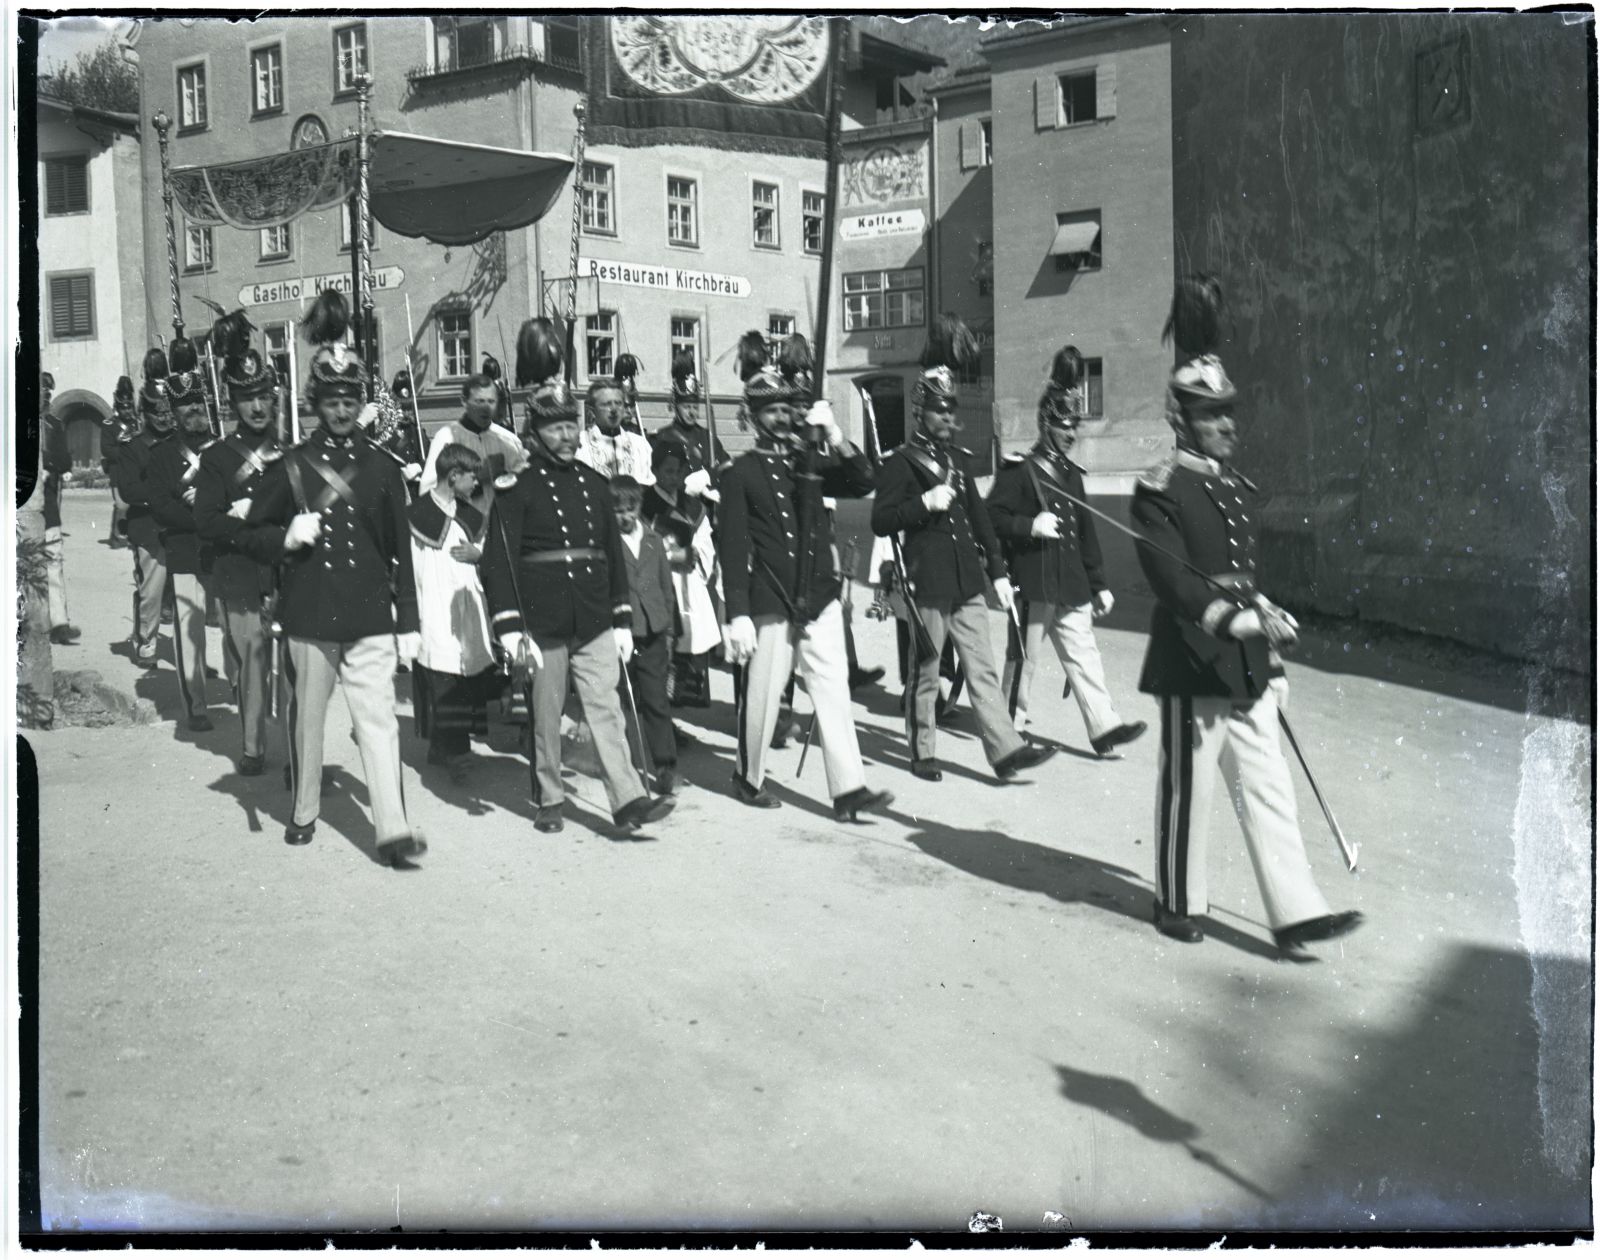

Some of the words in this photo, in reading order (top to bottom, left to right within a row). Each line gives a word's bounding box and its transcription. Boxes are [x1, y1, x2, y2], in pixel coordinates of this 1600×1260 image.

[858, 216, 902, 227] Kaffee
[314, 271, 386, 296] Kirchäu
[590, 260, 668, 286] Restaurant
[676, 269, 739, 294] Kirchbräu
